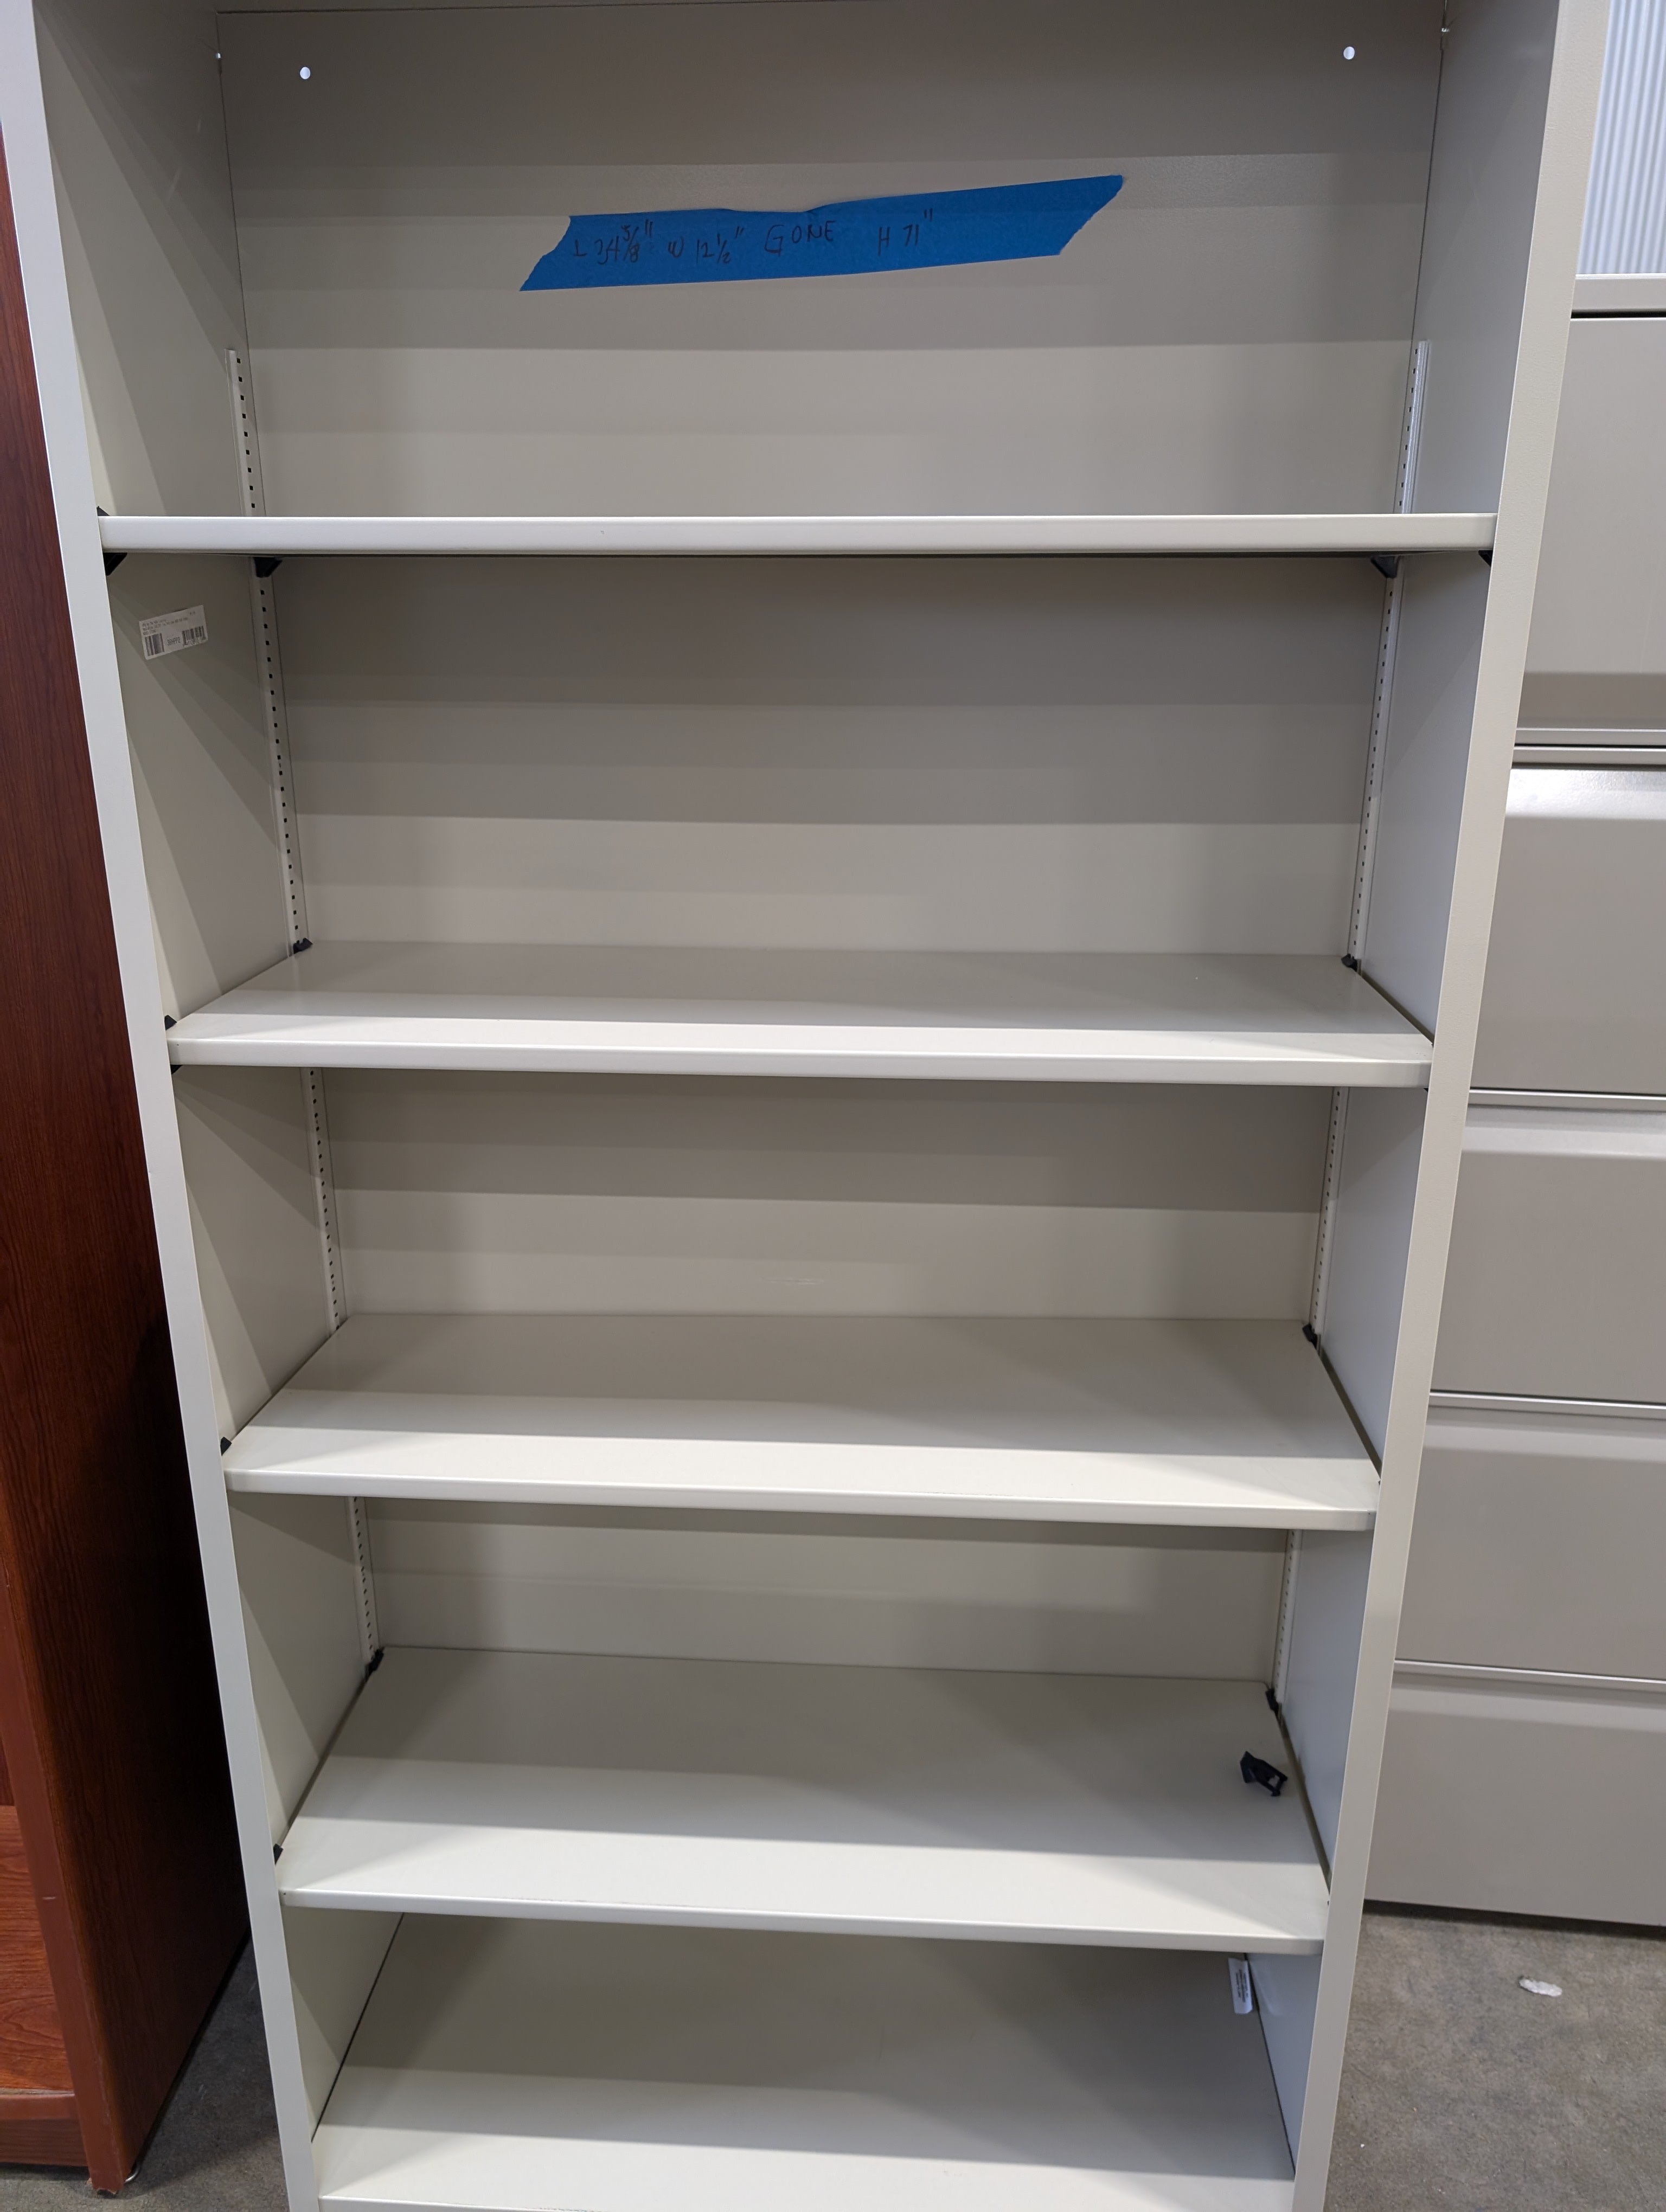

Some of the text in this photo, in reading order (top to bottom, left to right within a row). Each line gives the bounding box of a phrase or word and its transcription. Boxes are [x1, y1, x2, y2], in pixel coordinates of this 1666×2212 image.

[573, 239, 588, 257] L
[764, 220, 836, 257] GONE
[877, 226, 891, 257] H
